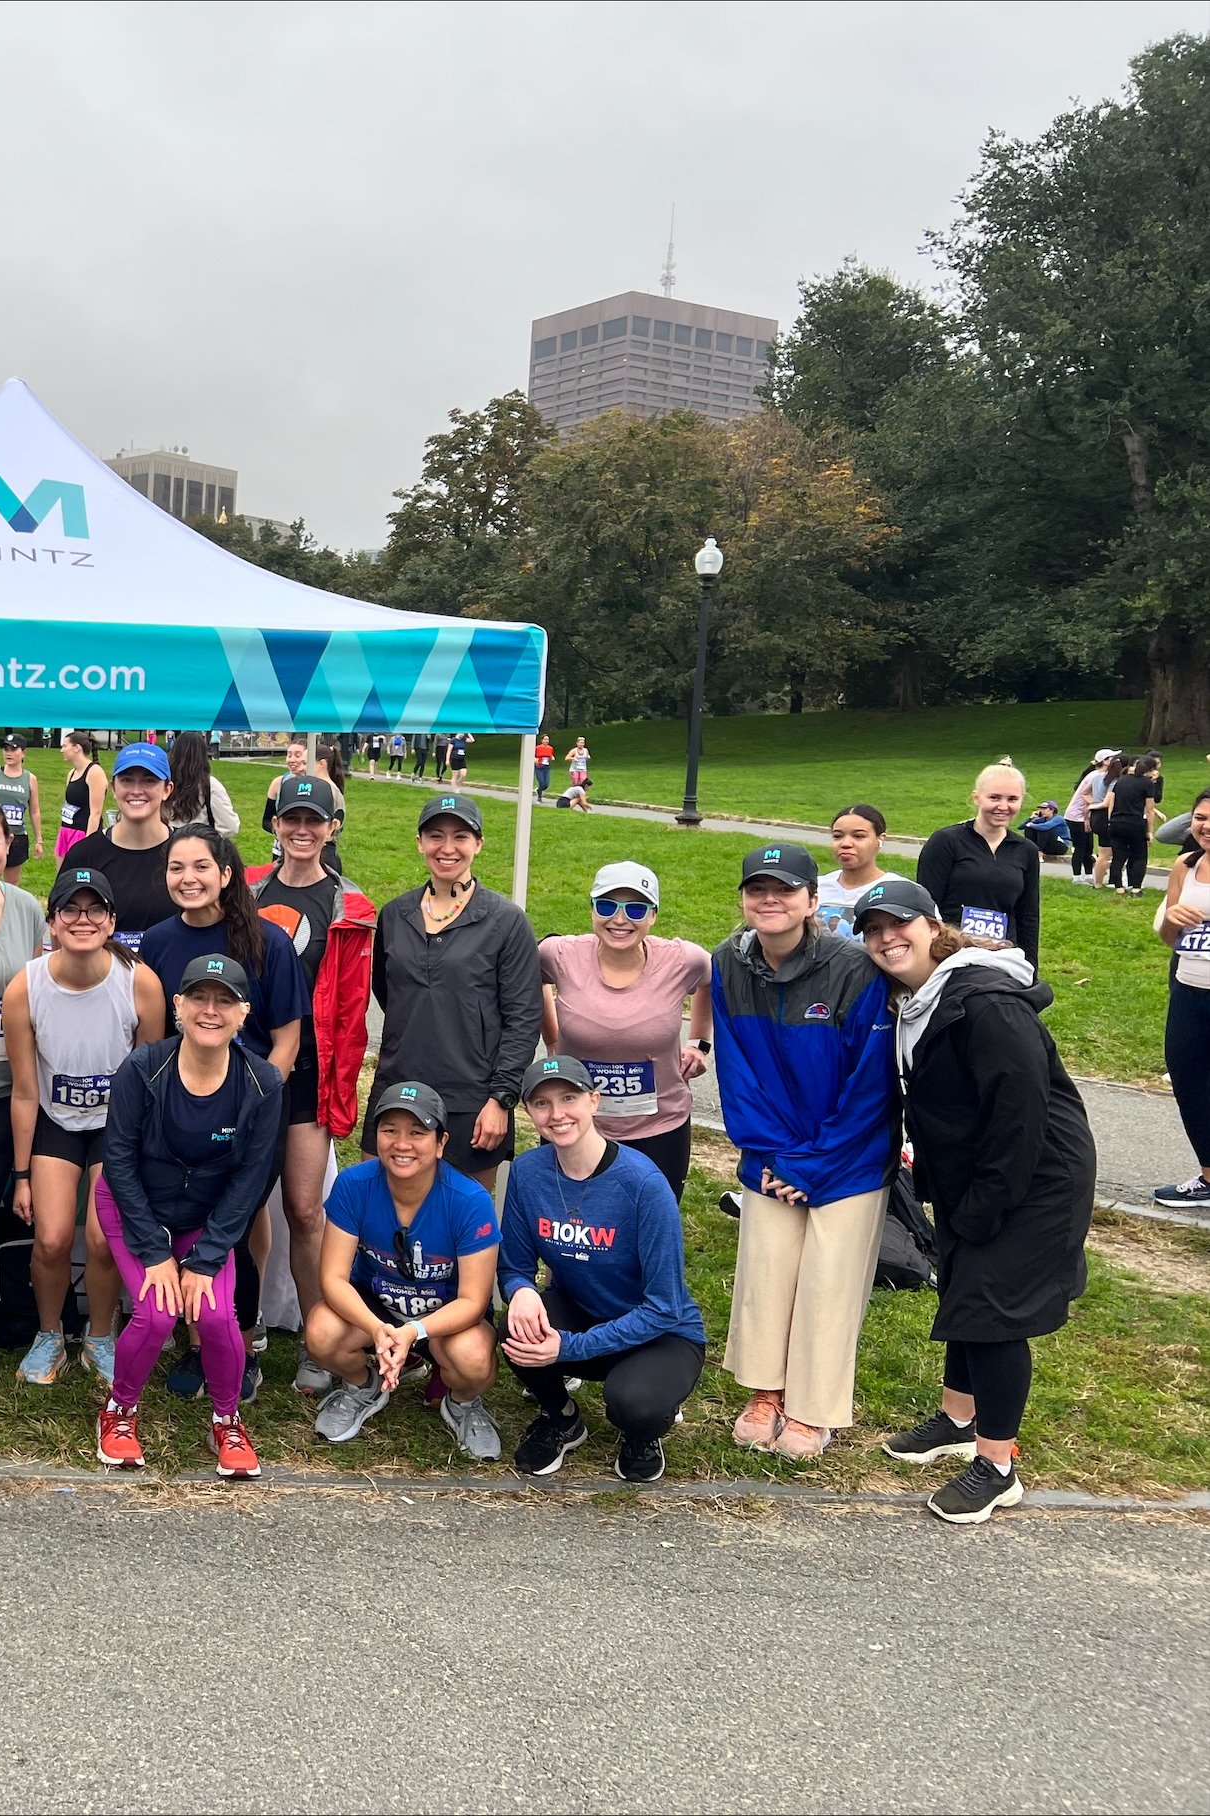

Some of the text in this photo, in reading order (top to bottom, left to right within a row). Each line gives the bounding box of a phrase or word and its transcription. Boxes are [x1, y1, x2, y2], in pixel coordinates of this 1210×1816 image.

[3, 809, 22, 820] 414
[963, 918, 1004, 939] 2943
[594, 1076, 642, 1095] 235
[56, 1086, 111, 1106] 1561
[538, 1218, 616, 1247] B10KW
[358, 1243, 454, 1273] ALMUTH
[388, 1287, 418, 1296] WOMEN
